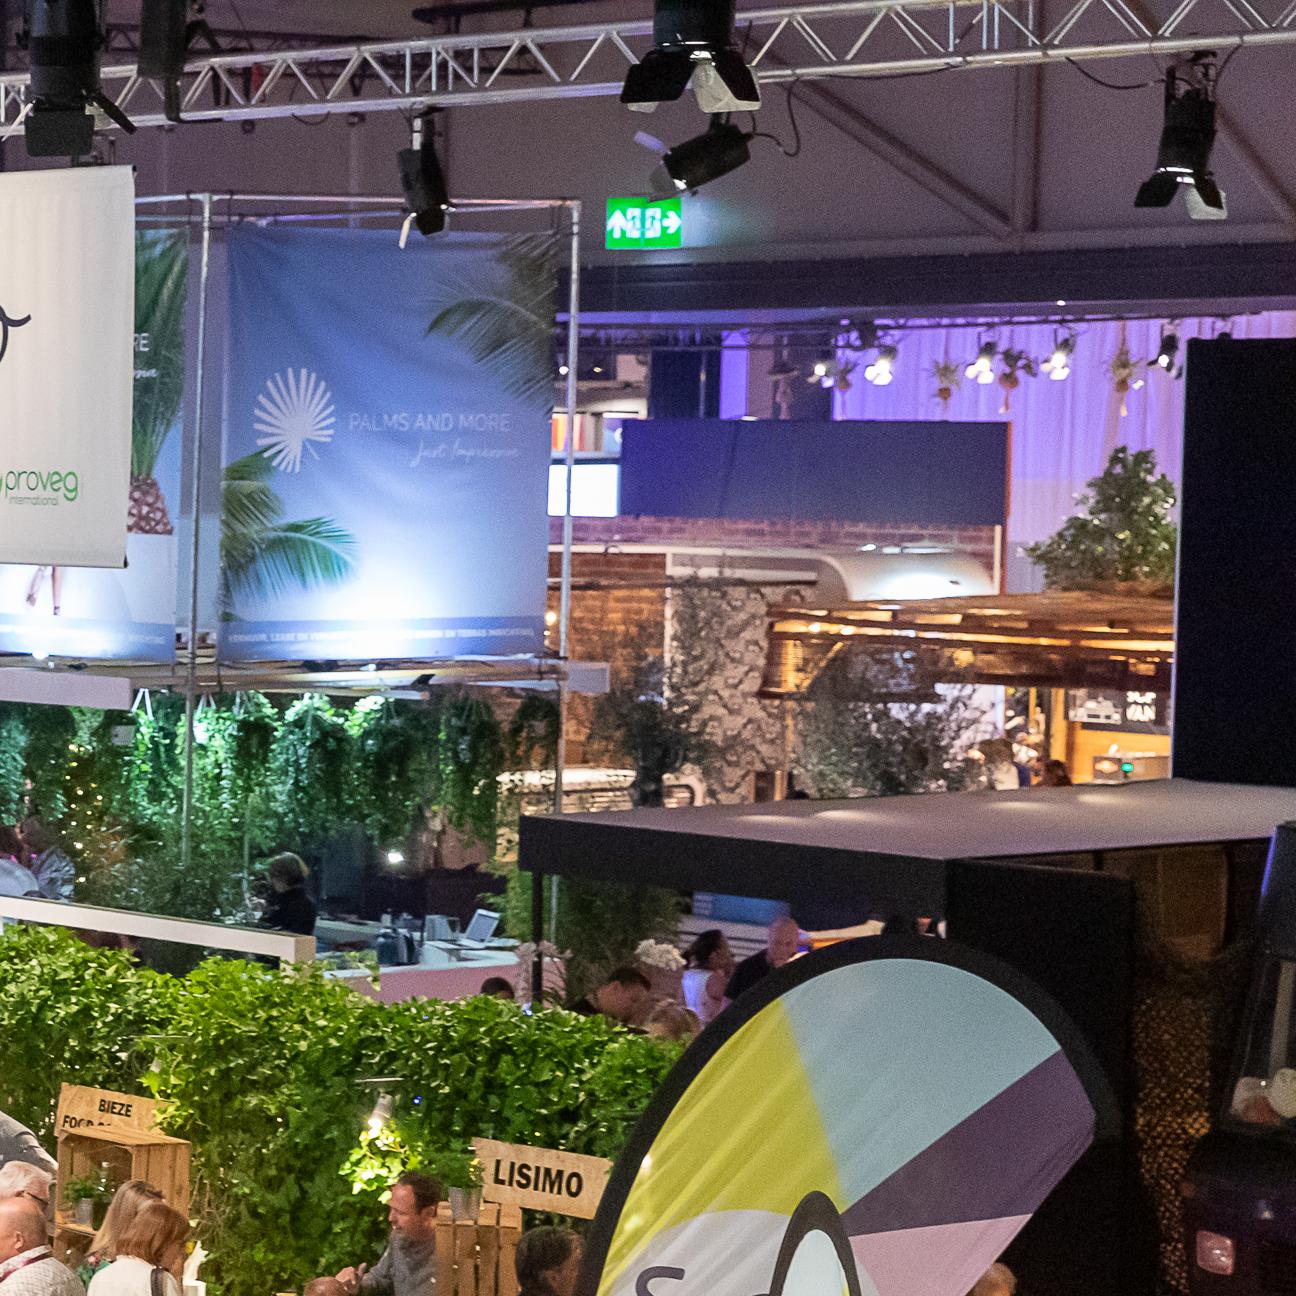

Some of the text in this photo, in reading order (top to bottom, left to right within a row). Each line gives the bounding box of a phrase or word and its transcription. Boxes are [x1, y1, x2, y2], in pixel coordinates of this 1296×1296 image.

[350, 413, 511, 431] PALMS AND MORE
[5, 470, 79, 502] proveg
[98, 1099, 132, 1117] BIEZE
[493, 1158, 584, 1199] LISIMO
